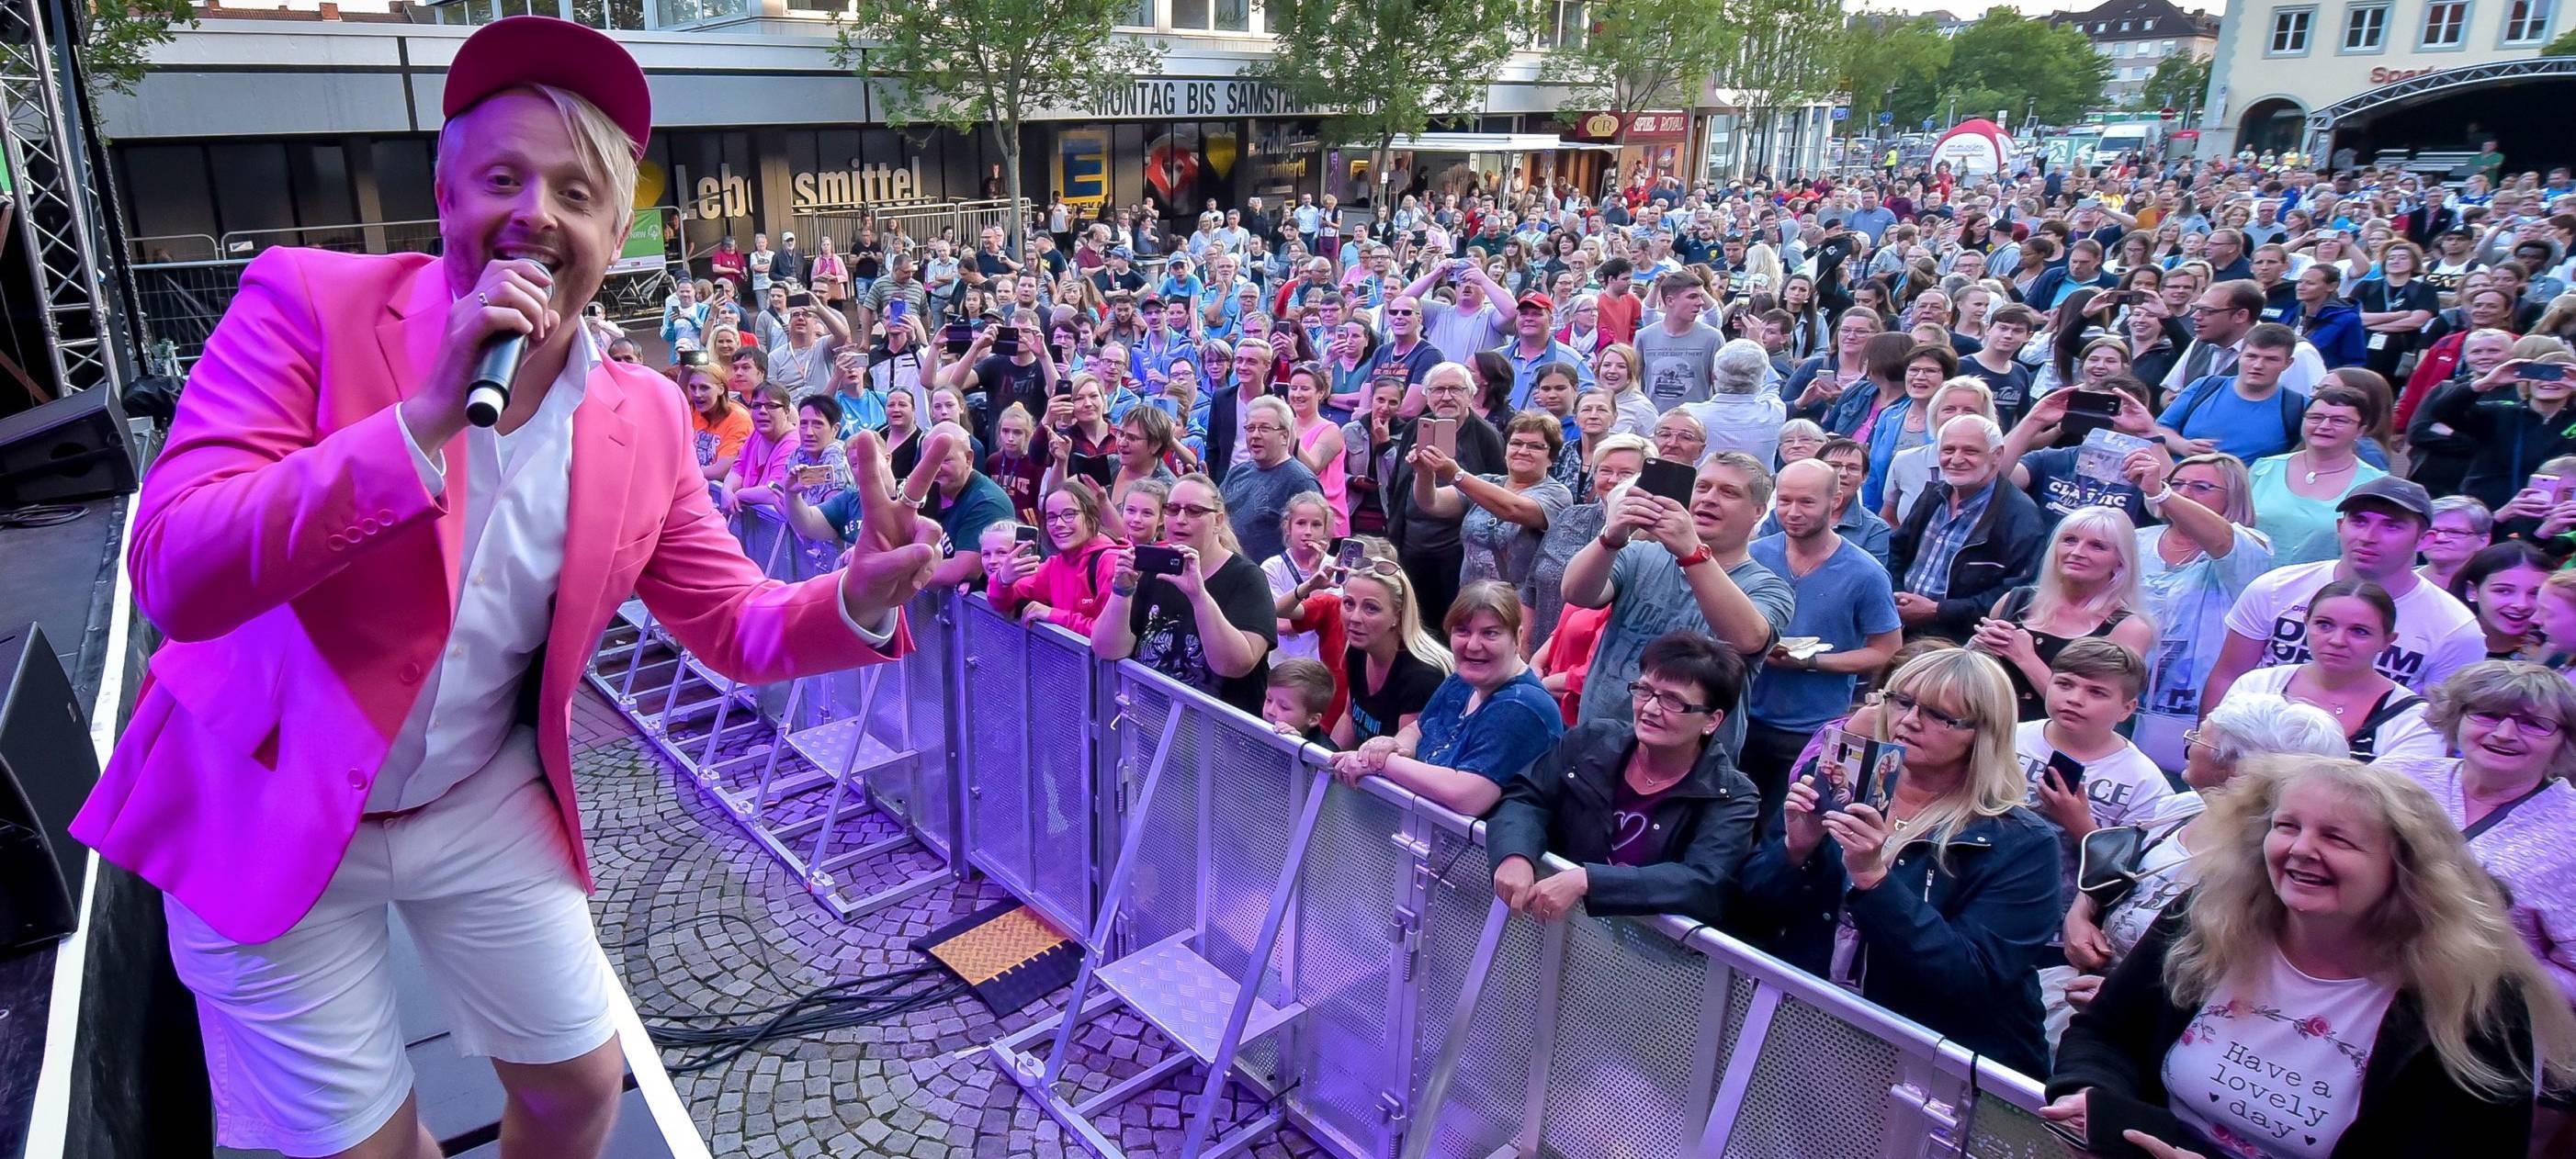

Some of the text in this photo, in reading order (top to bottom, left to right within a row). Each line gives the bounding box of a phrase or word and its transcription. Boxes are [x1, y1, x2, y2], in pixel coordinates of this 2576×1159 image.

[1187, 83, 1215, 115] BIS
[1659, 117, 1684, 131] ROYAL
[2222, 1041, 2333, 1098] Have a
[2209, 1063, 2330, 1127] lovely
[2229, 1099, 2296, 1138] day
